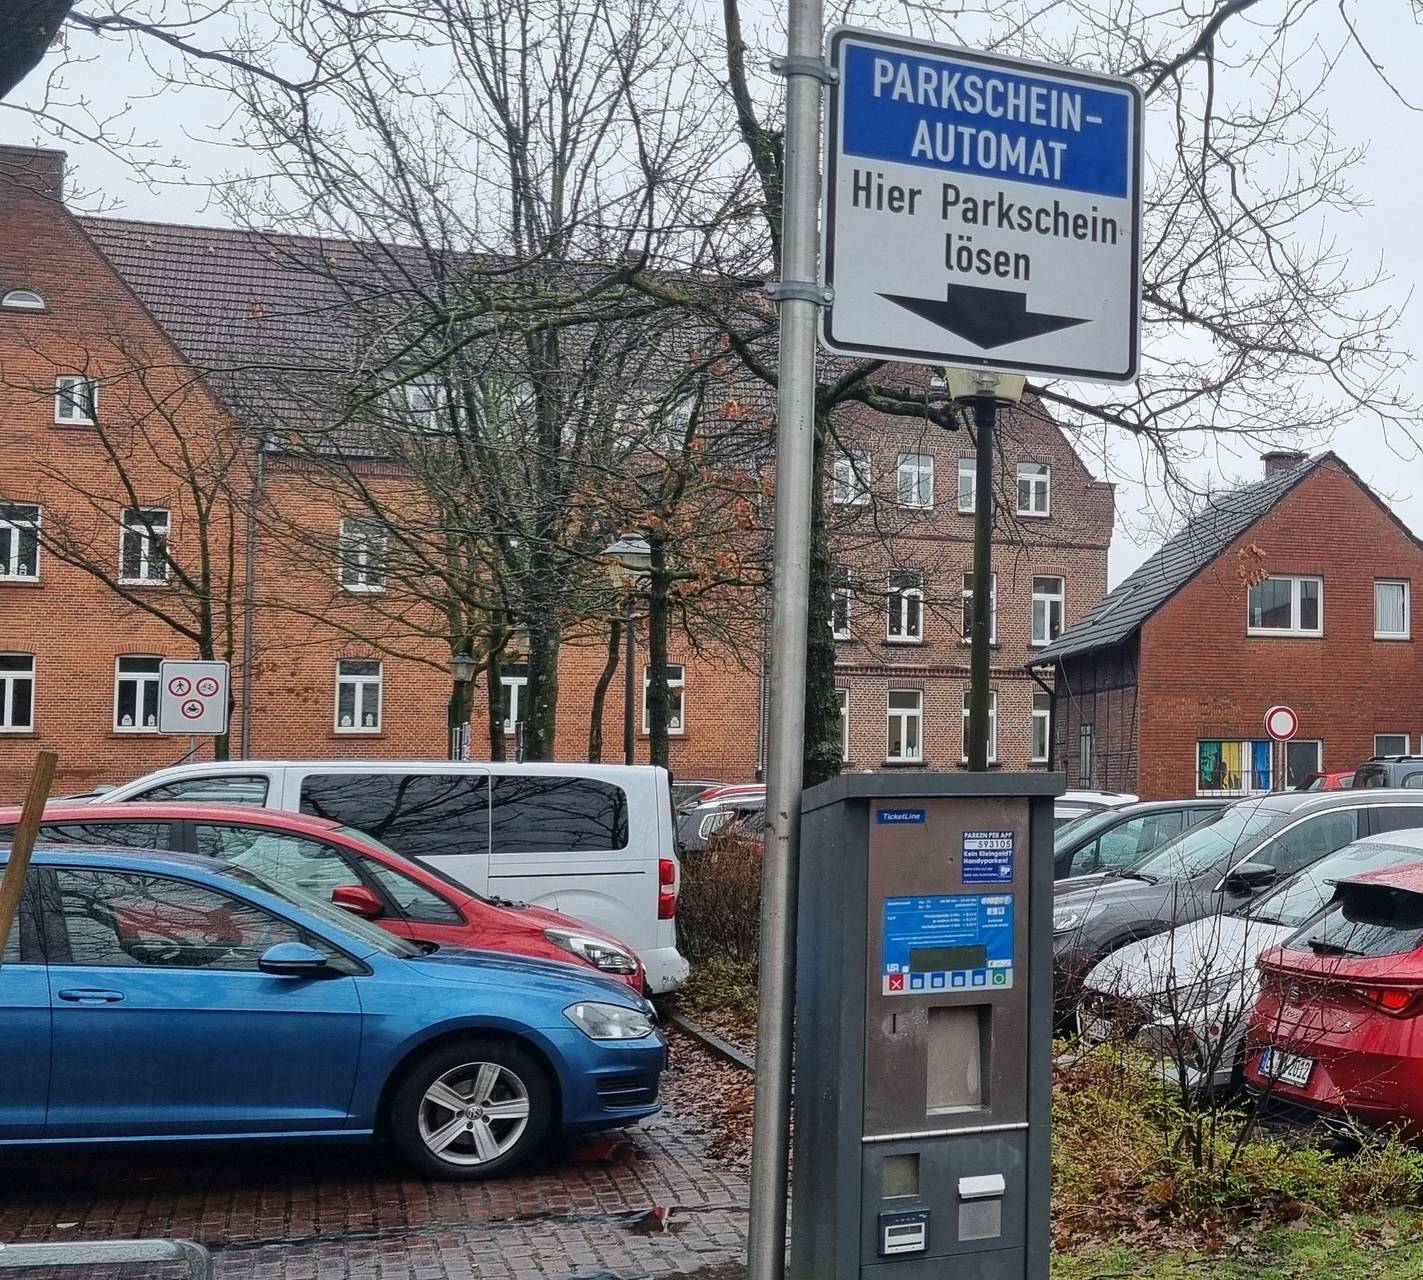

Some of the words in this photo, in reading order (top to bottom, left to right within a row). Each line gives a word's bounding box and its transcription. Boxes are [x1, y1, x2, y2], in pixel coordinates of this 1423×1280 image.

[873, 57, 1102, 132] PARKSCHEIN-
[911, 119, 1067, 180] AUTOMAT
[852, 169, 922, 215] Hier
[941, 183, 1118, 245] Parkschein
[945, 232, 1031, 281] lösen
[883, 812, 920, 820] TicketLine
[978, 840, 1011, 848] 593105
[1287, 1060, 1311, 1081] 2012
